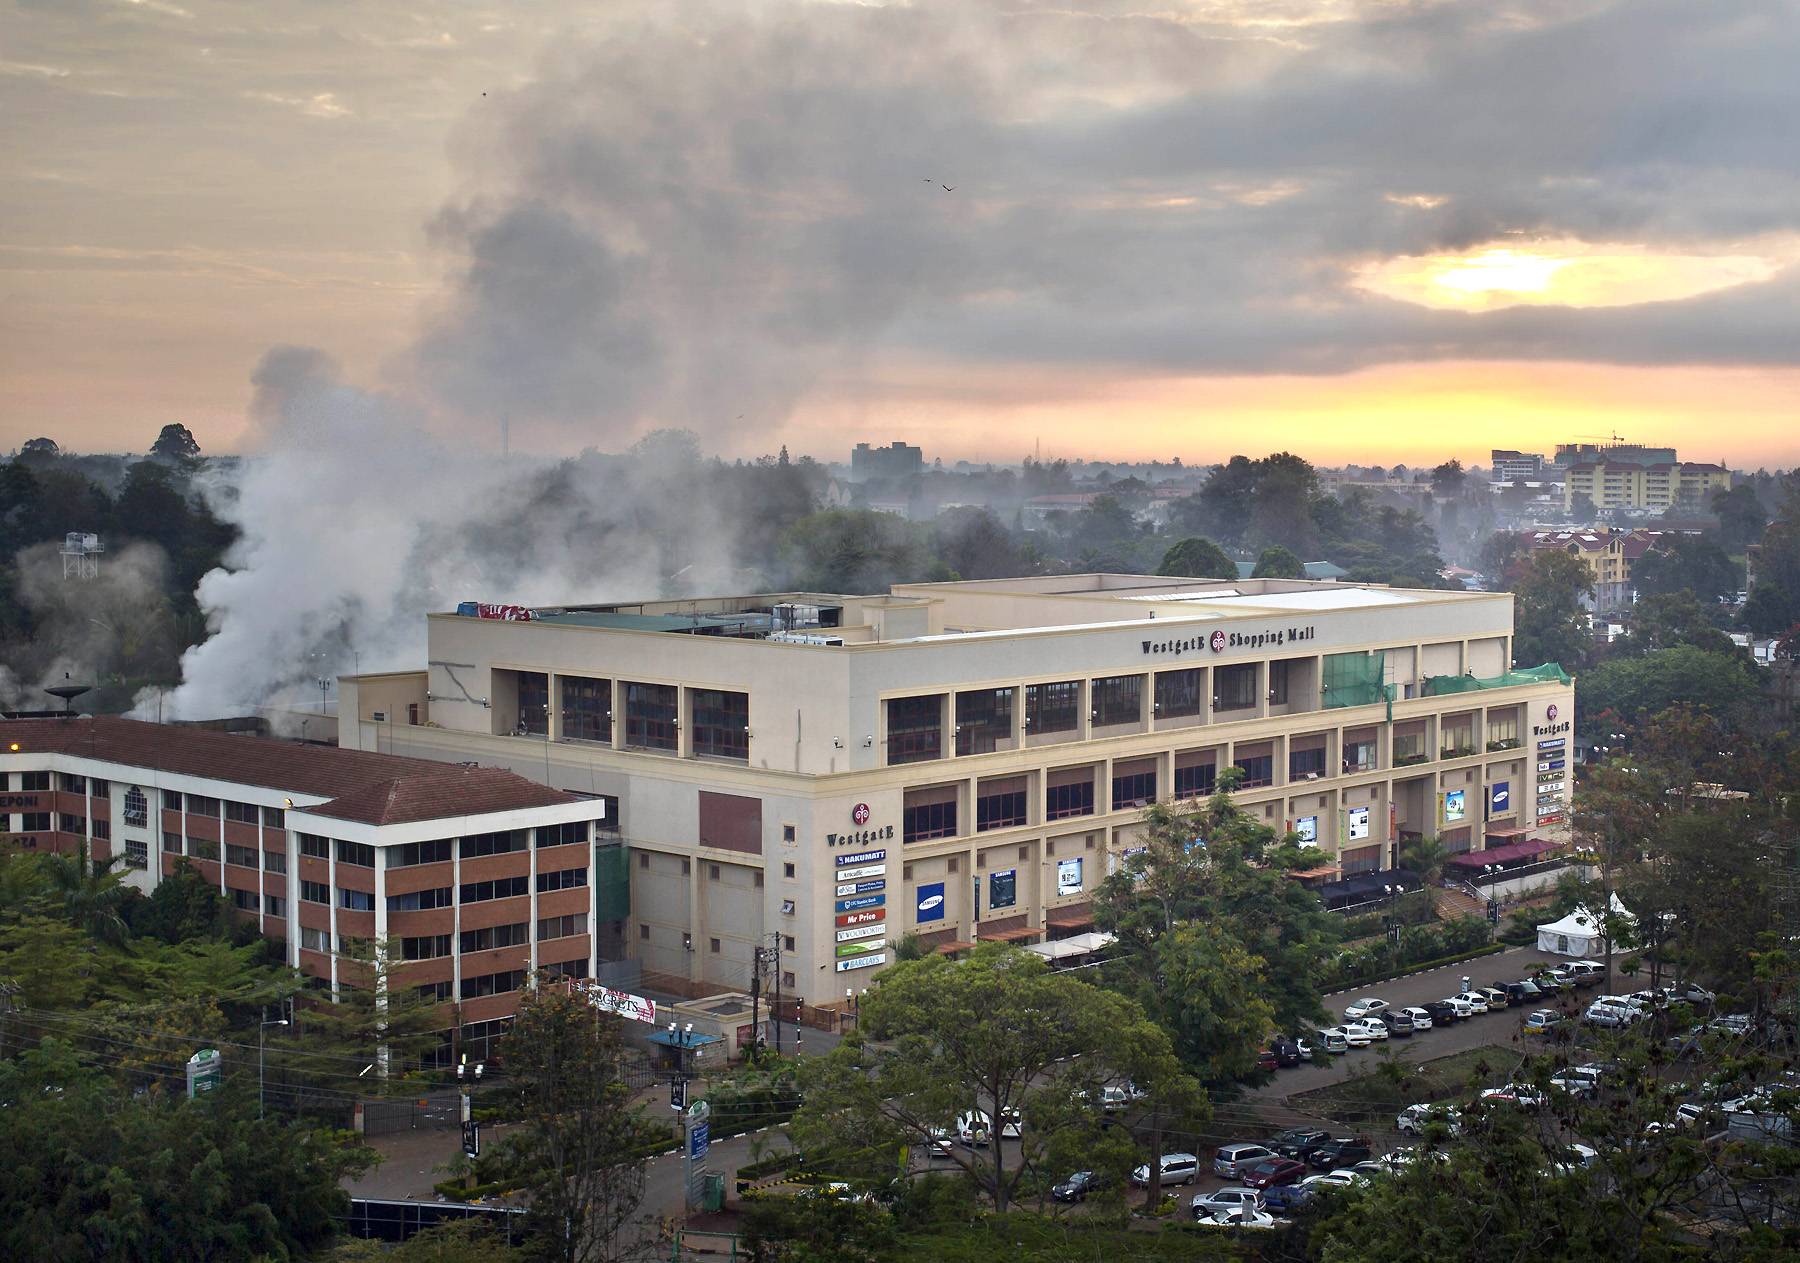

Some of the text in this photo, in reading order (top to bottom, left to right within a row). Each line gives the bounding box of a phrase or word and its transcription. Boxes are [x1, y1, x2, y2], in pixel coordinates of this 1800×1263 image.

[1229, 630, 1283, 648] Shopping
[1288, 626, 1315, 642] Mall
[844, 851, 885, 864] NAKUMATT
[848, 912, 876, 924] Mr Price
[845, 926, 885, 939] WOOLWORTHS
[850, 956, 879, 968] BARCLAYS
[589, 989, 638, 1012] SECRETS
